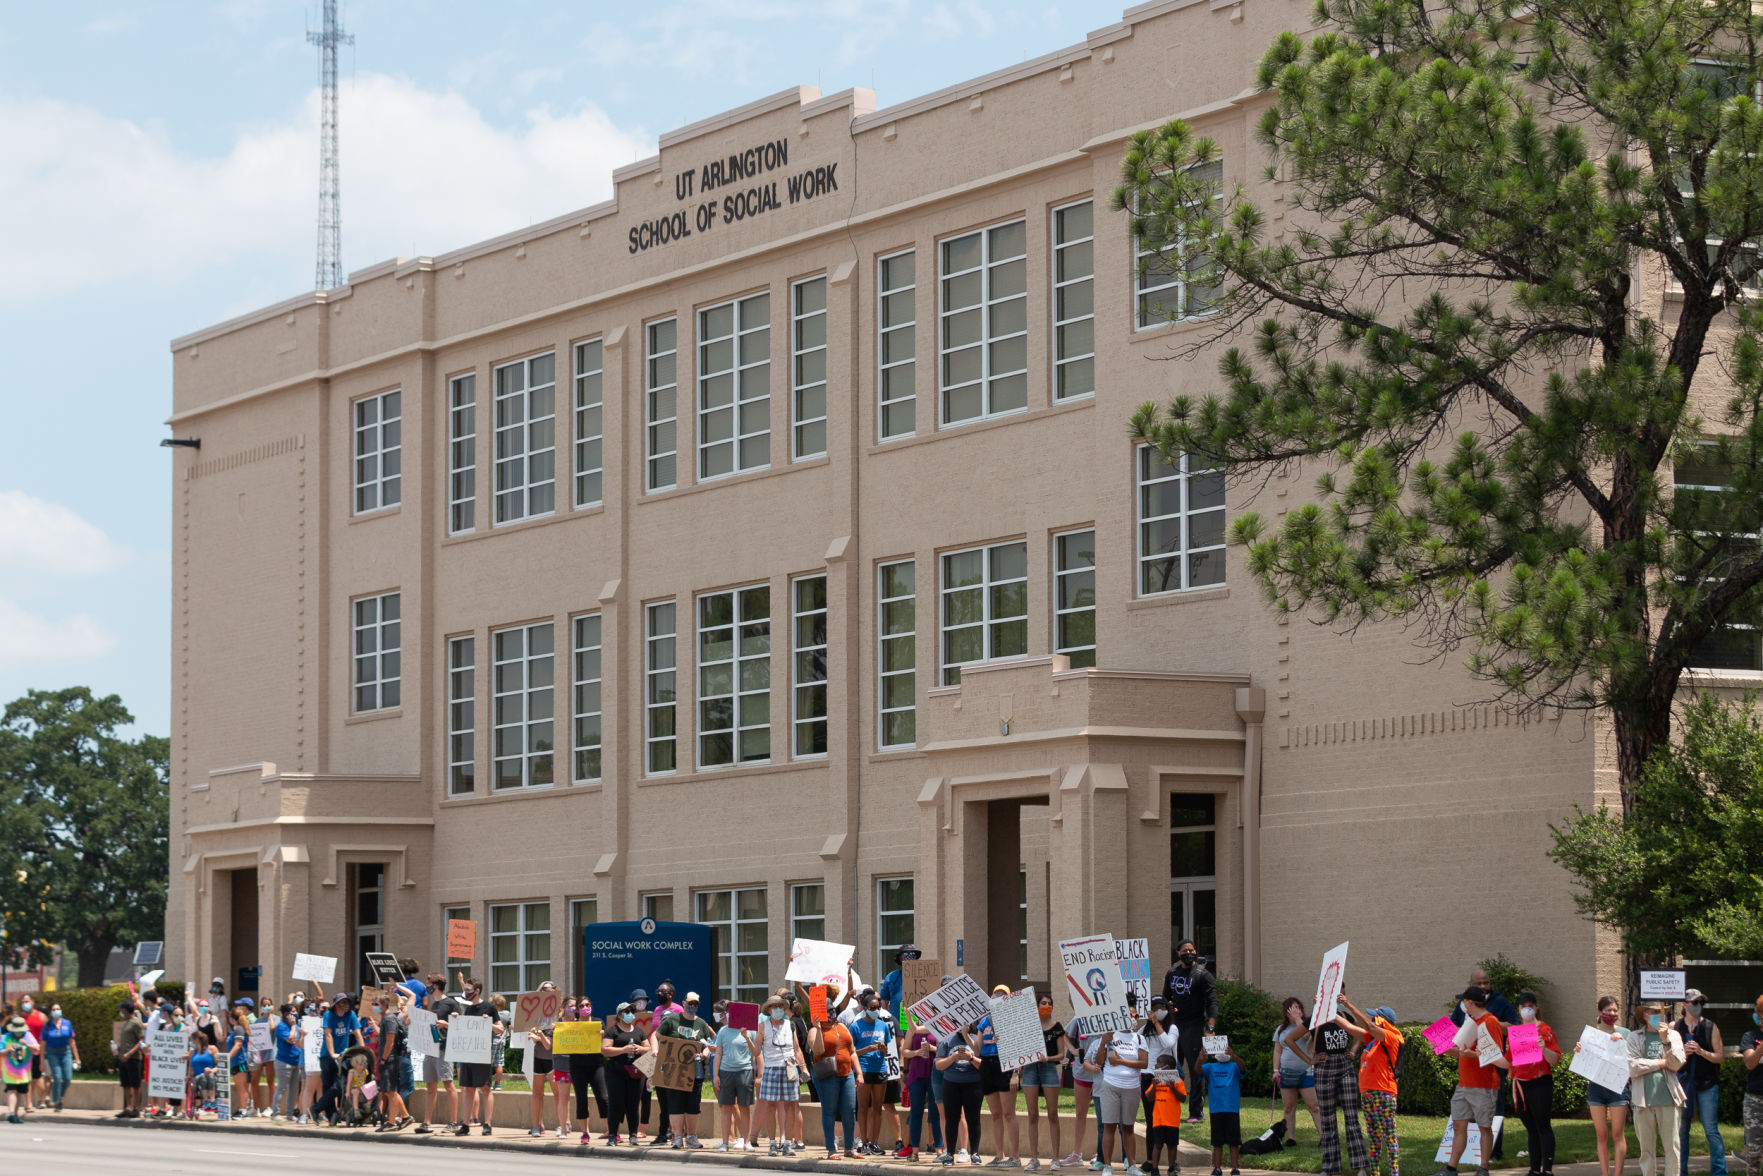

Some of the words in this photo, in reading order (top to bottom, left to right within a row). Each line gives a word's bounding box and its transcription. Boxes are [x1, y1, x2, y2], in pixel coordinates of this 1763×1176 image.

[676, 169, 695, 200] UT
[701, 138, 788, 192] ARLINGTON
[629, 211, 691, 254] SCHOOL
[697, 201, 717, 232] OF
[723, 182, 781, 224] SOCIAL
[788, 163, 838, 204] WORK
[592, 941, 623, 950] SOCIAL
[625, 941, 651, 950] WORK
[654, 941, 693, 950] COMPLEX
[1115, 940, 1145, 959] BLACK
[1064, 952, 1086, 966] END
[1088, 948, 1116, 962] Racism
[904, 962, 938, 978] SILENCE
[1118, 960, 1146, 978] TRANS
[914, 979, 928, 994] IS
[1126, 980, 1147, 998] IVES
[909, 999, 942, 1023] KNOW
[937, 976, 980, 1010] JUSTICE
[1093, 989, 1112, 1006] IN
[930, 1012, 962, 1037] KNOW
[955, 996, 990, 1023] PEACE
[1078, 1012, 1122, 1034] HIGHER
[1002, 1052, 1043, 1070] FLOYD
